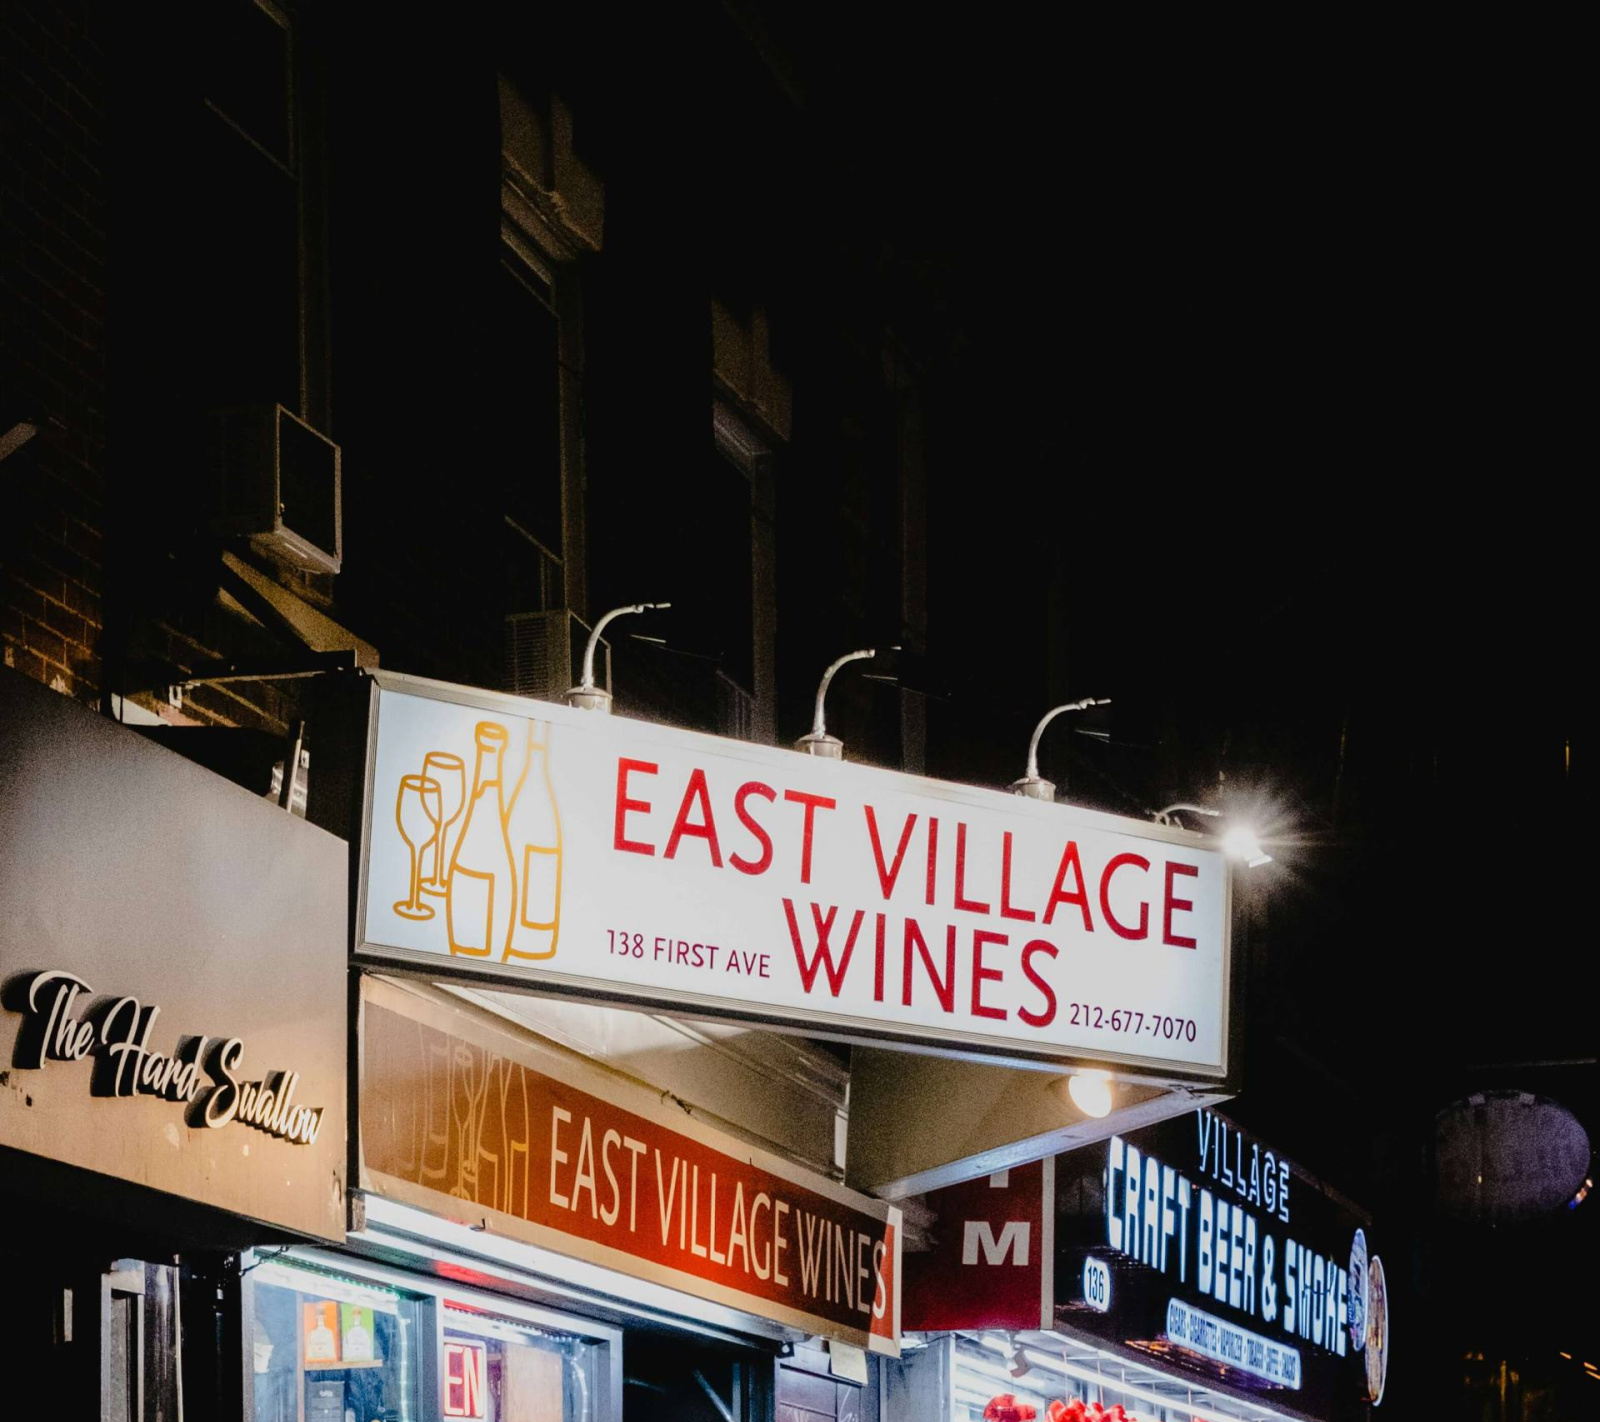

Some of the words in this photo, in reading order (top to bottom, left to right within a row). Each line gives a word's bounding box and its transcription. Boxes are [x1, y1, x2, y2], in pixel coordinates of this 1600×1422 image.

[613, 756, 838, 885] EAST
[863, 804, 1199, 950] VILLAGE
[607, 930, 644, 959] 138
[654, 936, 720, 969] FIRST
[726, 950, 771, 978] AVE
[782, 897, 1059, 1028] WINES
[29, 970, 94, 1069] The
[101, 996, 208, 1102] Hard
[205, 1038, 325, 1145] Swallow
[1071, 1003, 1197, 1043] 212-677-7070
[550, 1105, 647, 1233] EAST
[655, 1148, 789, 1287] VILLAGE
[797, 1209, 886, 1320] WINES
[1197, 1108, 1290, 1223] VILLAGE
[1088, 1265, 1105, 1304] 136
[1108, 1135, 1191, 1283] CRAFT
[1198, 1189, 1256, 1316] BEER
[1261, 1235, 1277, 1322] &
[1284, 1238, 1348, 1357] SMOKE
